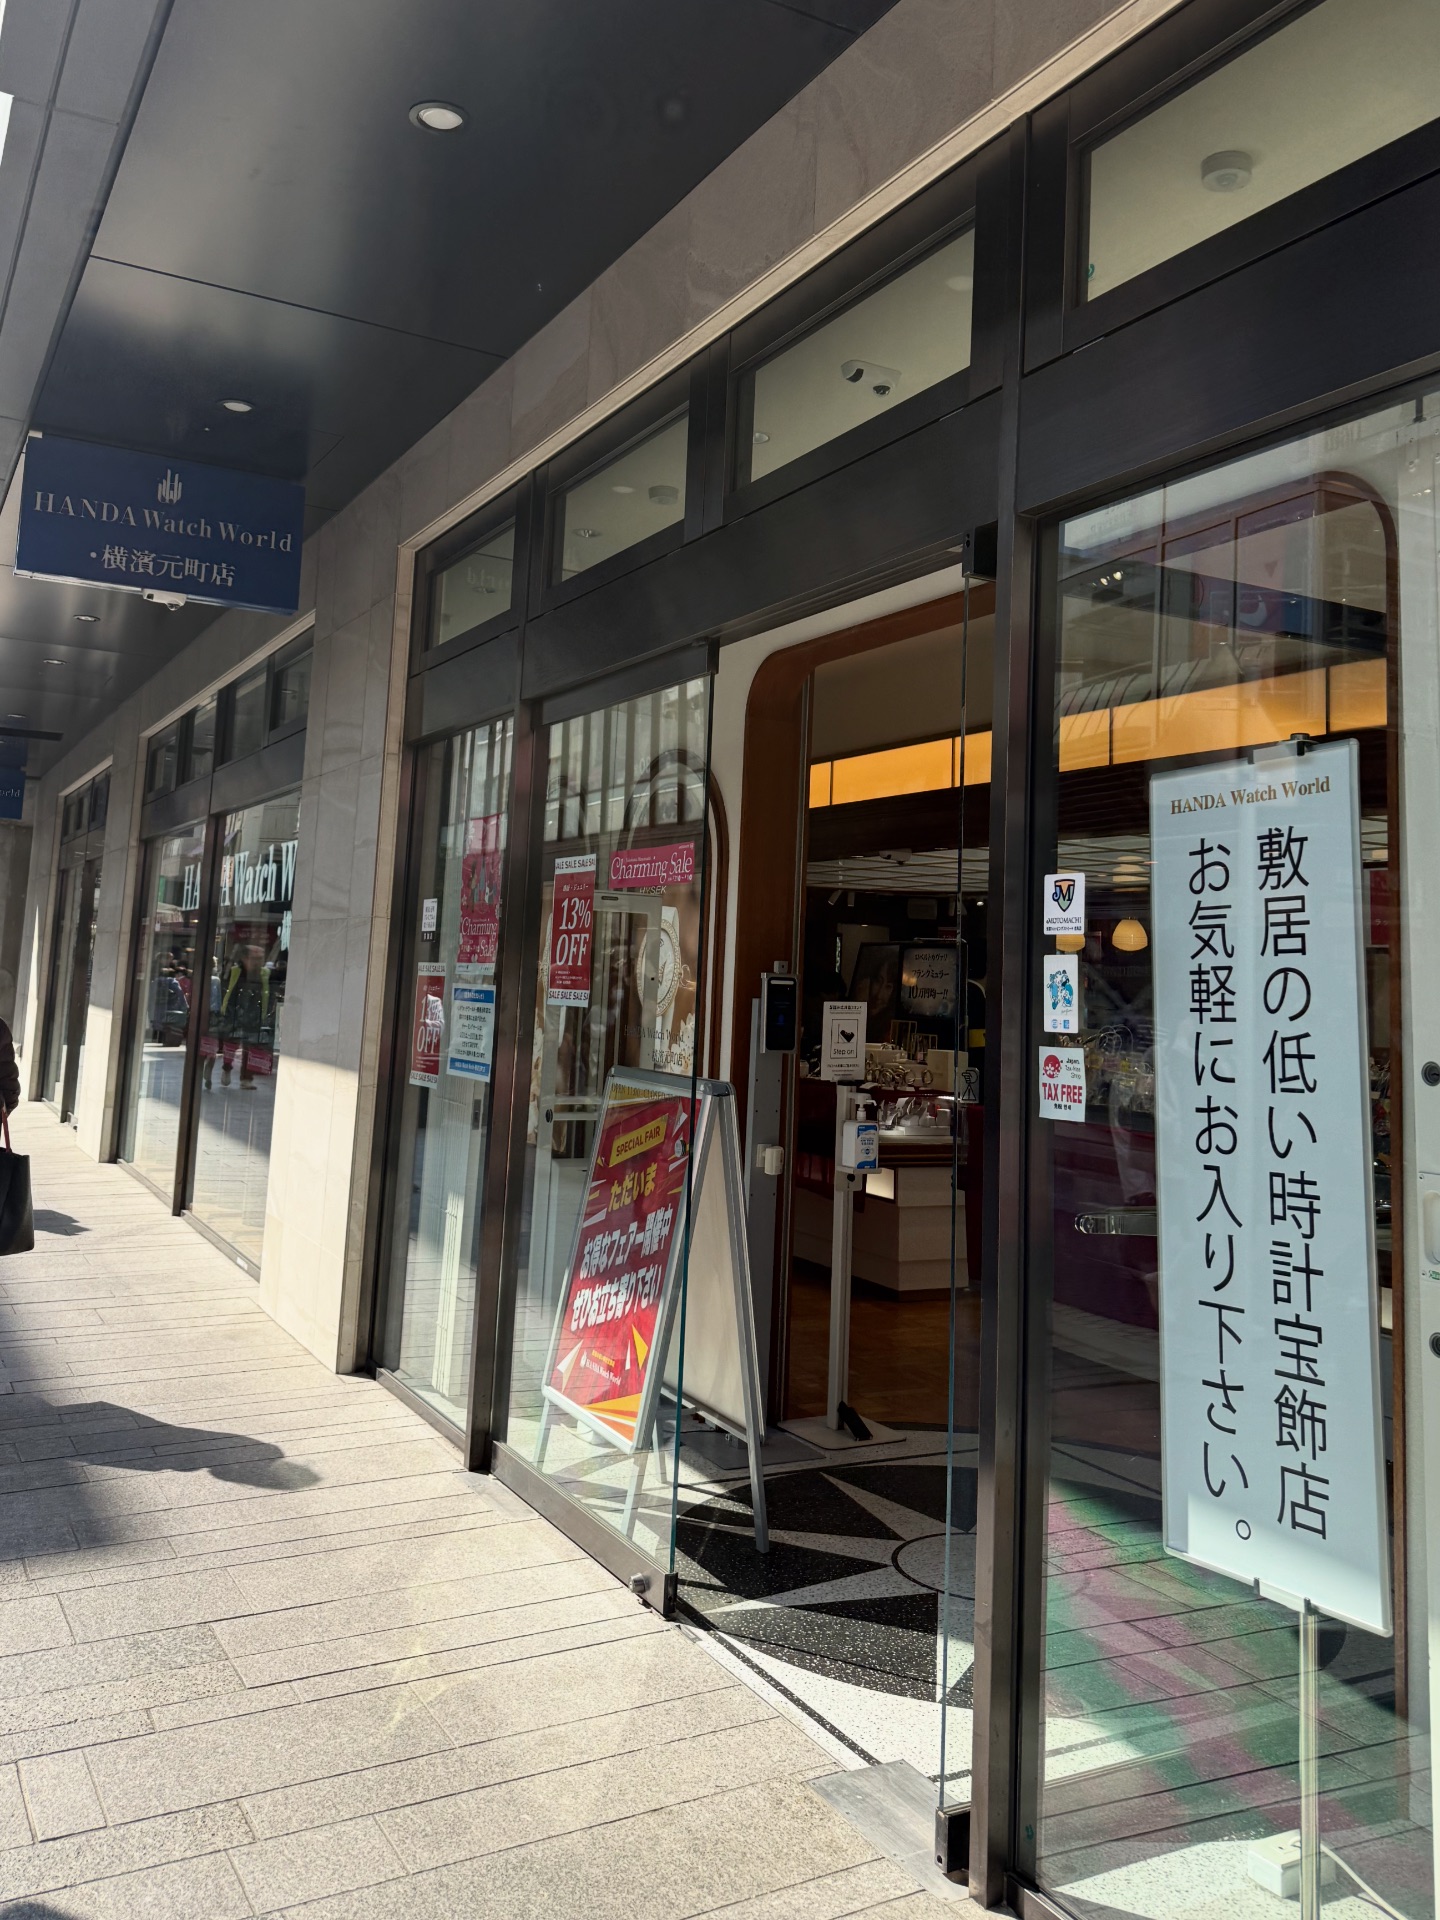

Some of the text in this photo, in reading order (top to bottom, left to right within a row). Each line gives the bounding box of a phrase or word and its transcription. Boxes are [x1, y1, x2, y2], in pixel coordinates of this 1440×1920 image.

[33, 491, 293, 552] HANDA Watch World
[1170, 776, 1331, 815] HANDA Watch World
[182, 854, 230, 911] HAA
[234, 843, 278, 906] Watch
[611, 850, 693, 884] Charming Sale
[461, 917, 498, 940] Charming
[559, 898, 591, 930] 13%
[556, 934, 589, 966] OFF
[416, 1027, 440, 1053] OFF
[1041, 1082, 1083, 1104] TAX FREE
[615, 1125, 661, 1157] SPECIAL FAIR
[608, 1162, 658, 1212] ただいま
[1188, 837, 1252, 1542] お気軽にお入り下さい。
[1256, 825, 1331, 1541] 敷居の低い時計宝飾店
[579, 1203, 673, 1280] お得なフェアー開催中
[570, 1263, 662, 1332] ぜひお立ち寄り下さい
